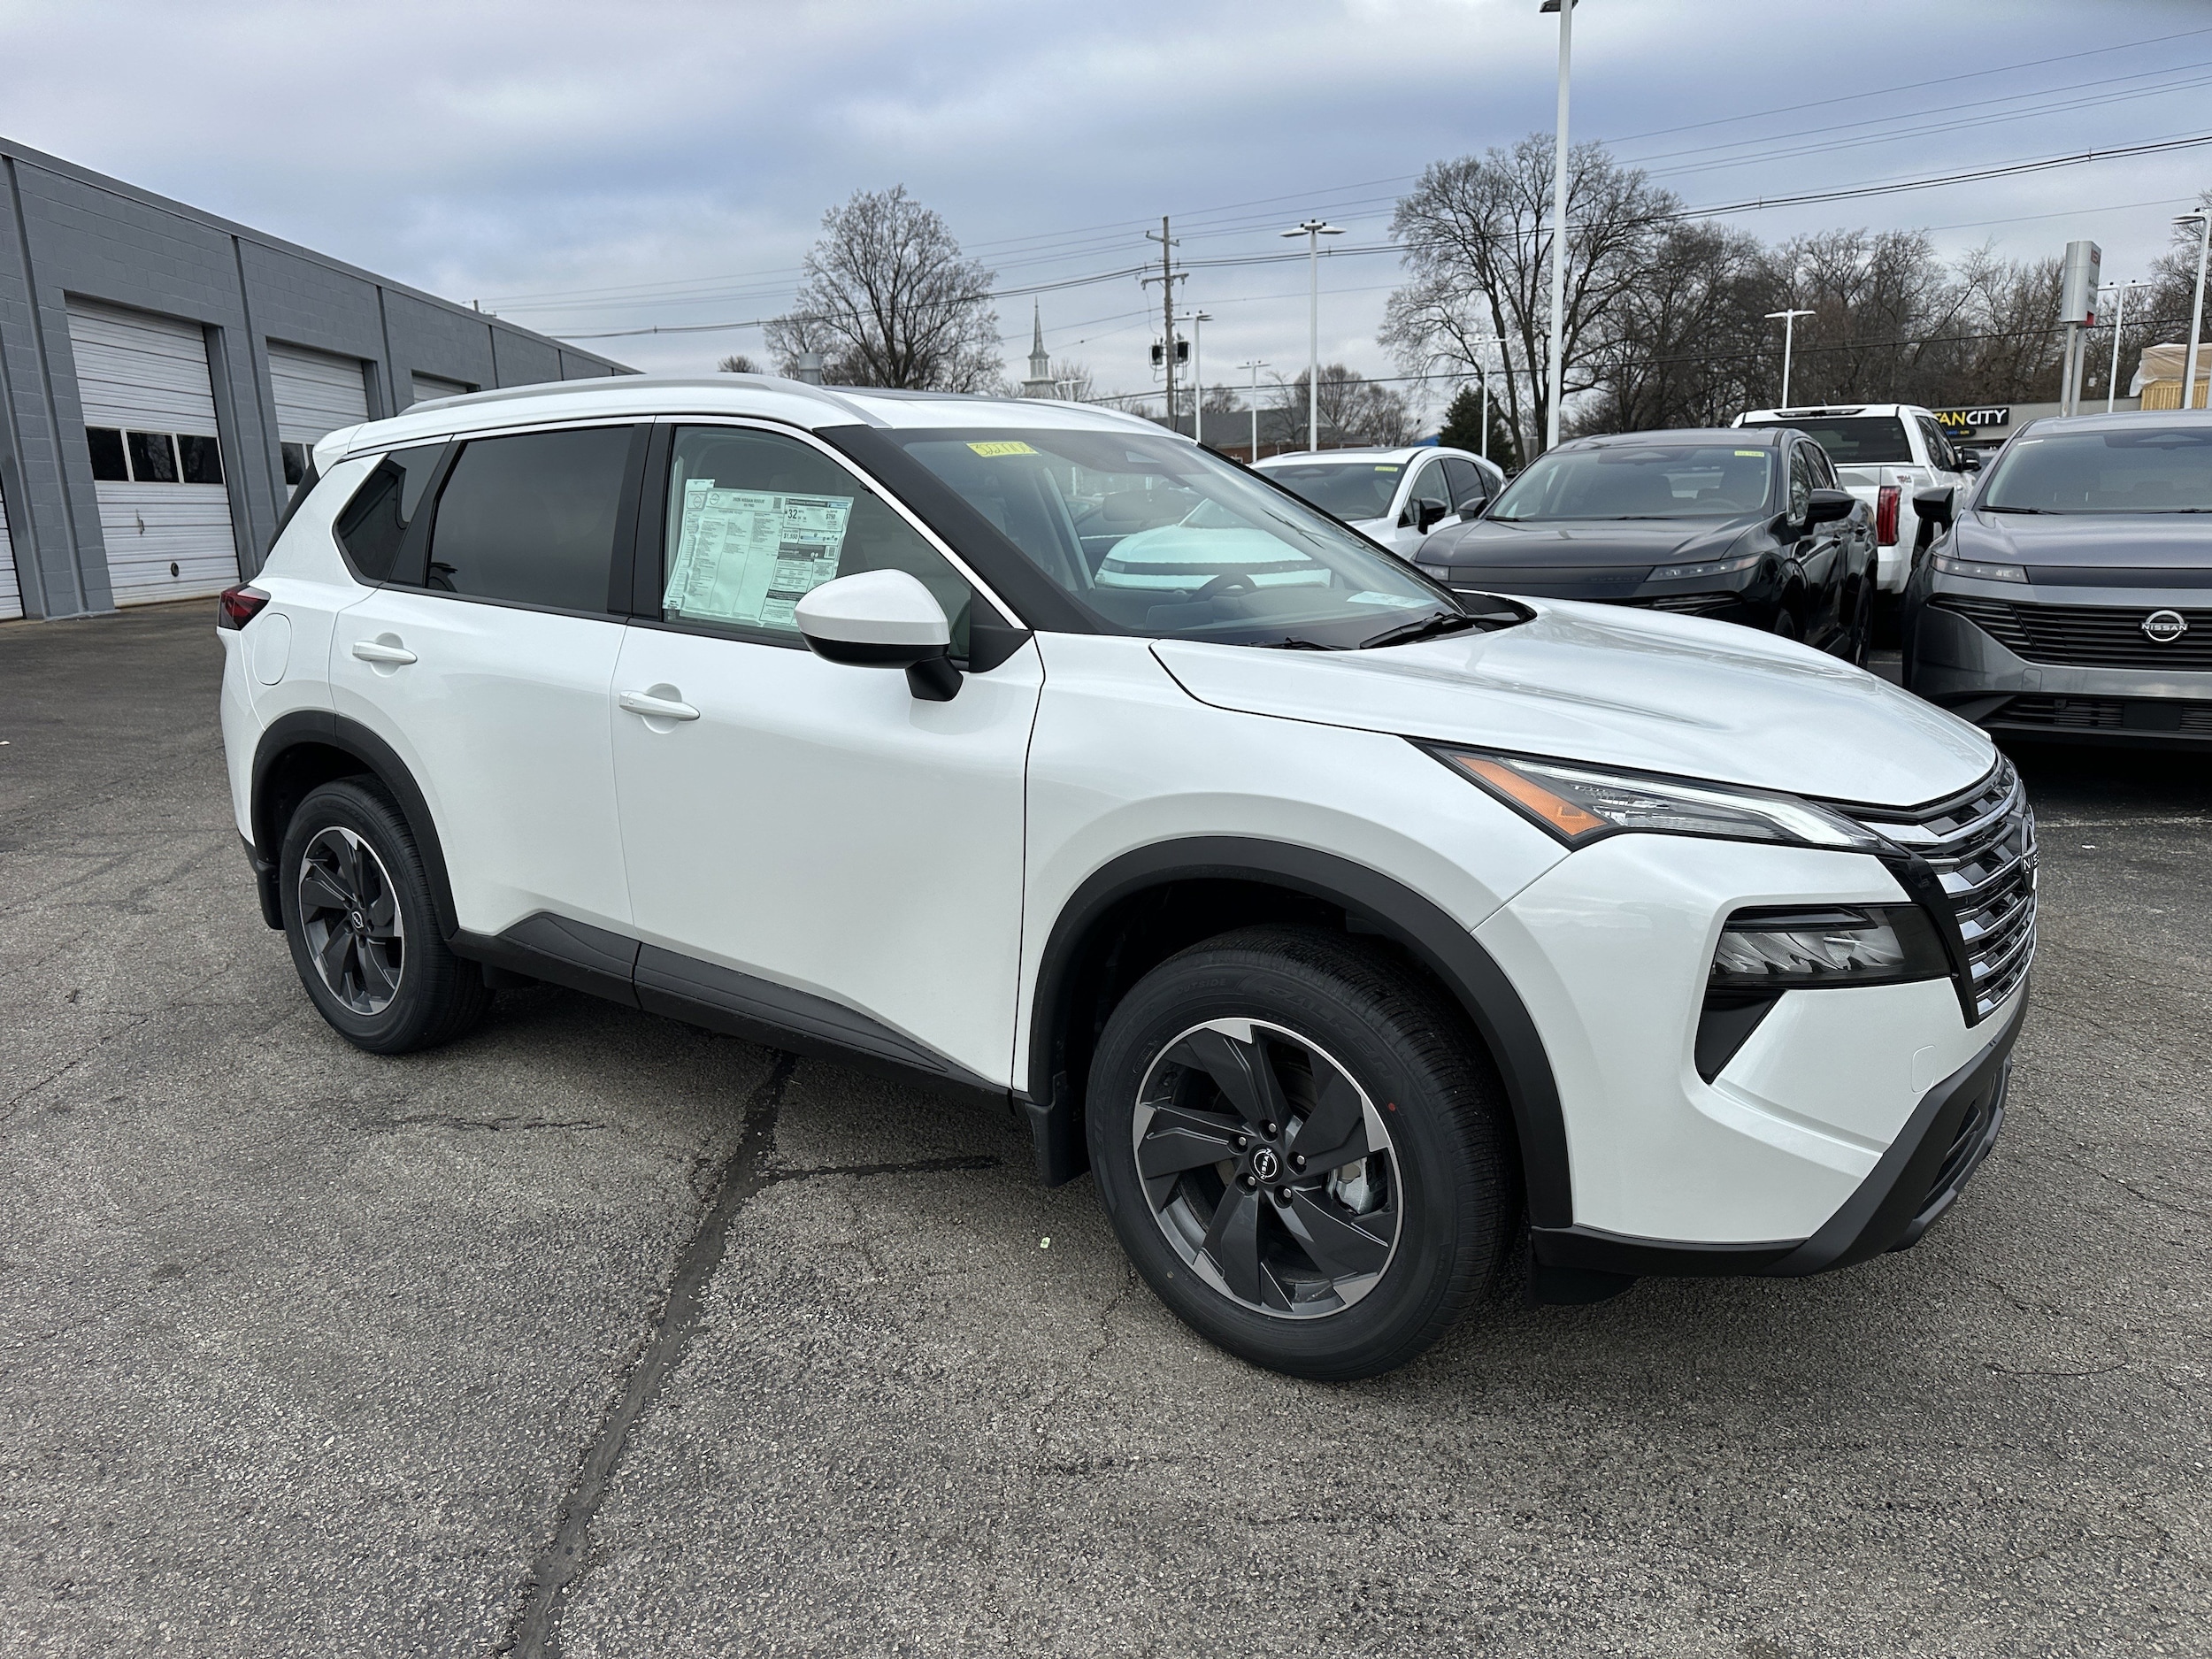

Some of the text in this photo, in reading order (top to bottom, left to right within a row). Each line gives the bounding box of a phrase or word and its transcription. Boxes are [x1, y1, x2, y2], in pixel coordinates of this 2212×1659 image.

[787, 509, 798, 519] 32
[2142, 622, 2188, 631] NISSAN
[1177, 978, 1227, 995] OUTSIDE
[1260, 1148, 1272, 1179] NISSAN
